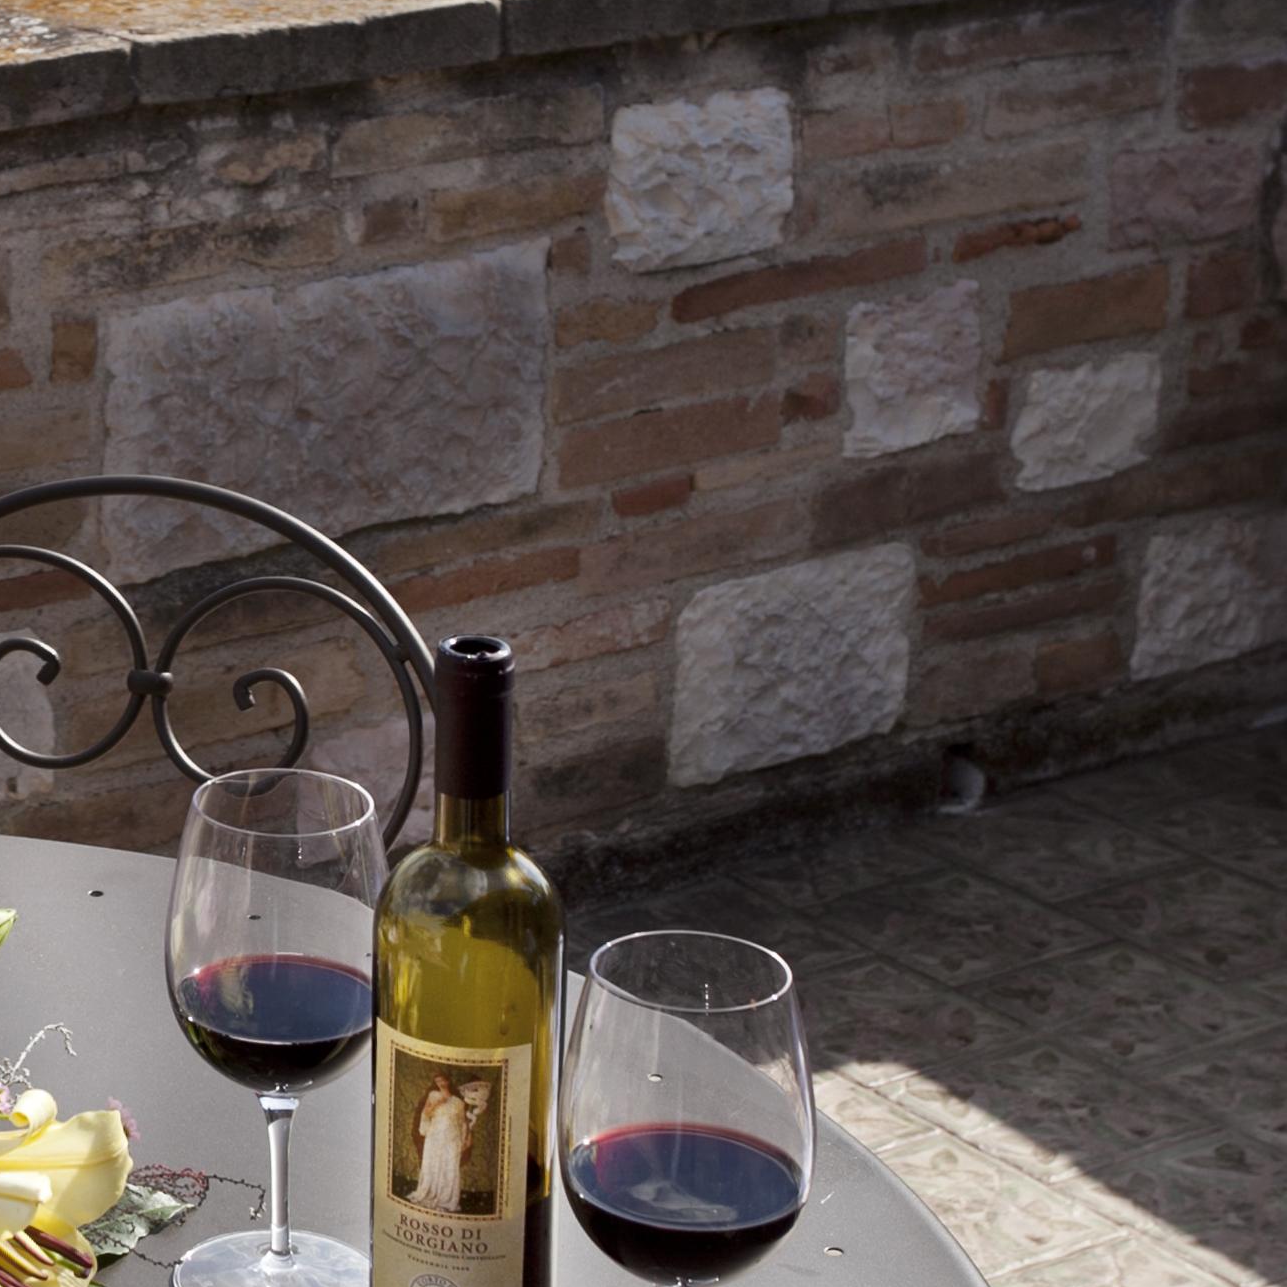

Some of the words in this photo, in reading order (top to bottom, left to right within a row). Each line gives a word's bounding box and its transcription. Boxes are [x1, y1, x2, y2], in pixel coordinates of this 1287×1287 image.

[395, 1224, 488, 1253] TORGIANO
[400, 1214, 453, 1238] ROSSO
[462, 1228, 481, 1240] DI
